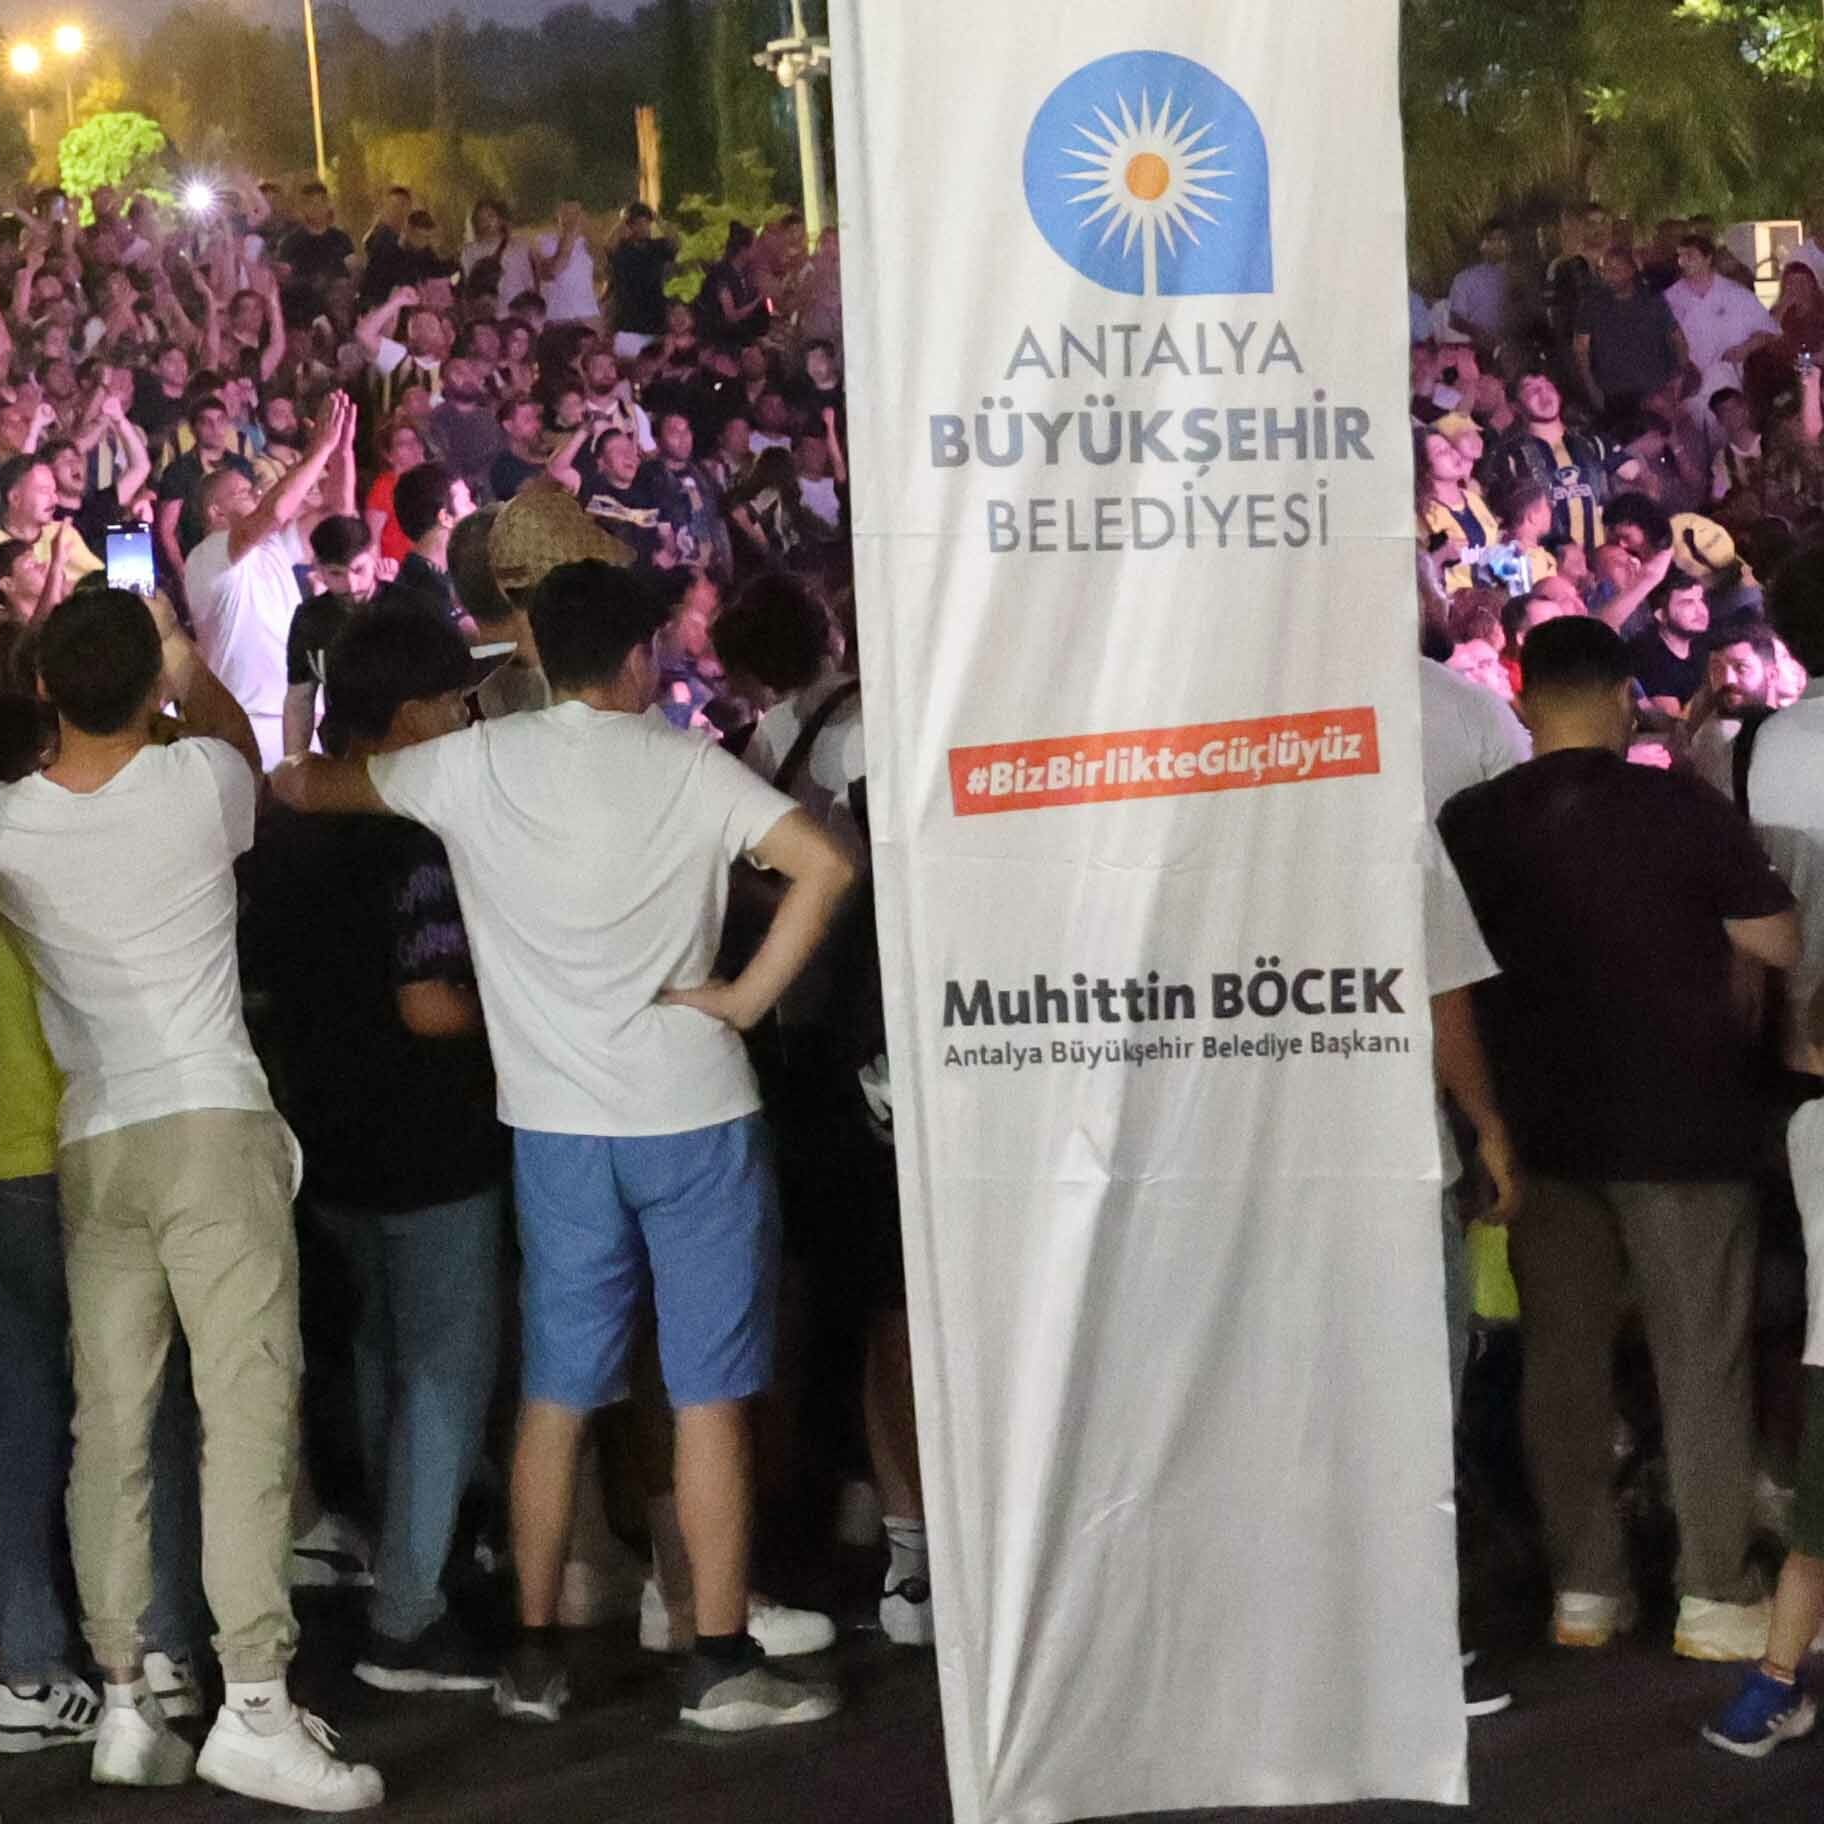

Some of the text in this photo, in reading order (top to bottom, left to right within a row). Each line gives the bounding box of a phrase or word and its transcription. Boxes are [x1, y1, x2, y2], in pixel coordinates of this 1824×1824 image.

[1004, 320, 1304, 379] ANTALYA
[929, 388, 1375, 477] BÜYÜKŞEHİR
[987, 479, 1329, 553] BELEDİYESİ
[966, 726, 1361, 796] #BizBirlikteGüçlüyüz
[943, 956, 1405, 1028] Muhittin BÖCEK
[944, 1030, 1409, 1071] Antalya Büyükşehir Belediye Başkanı
